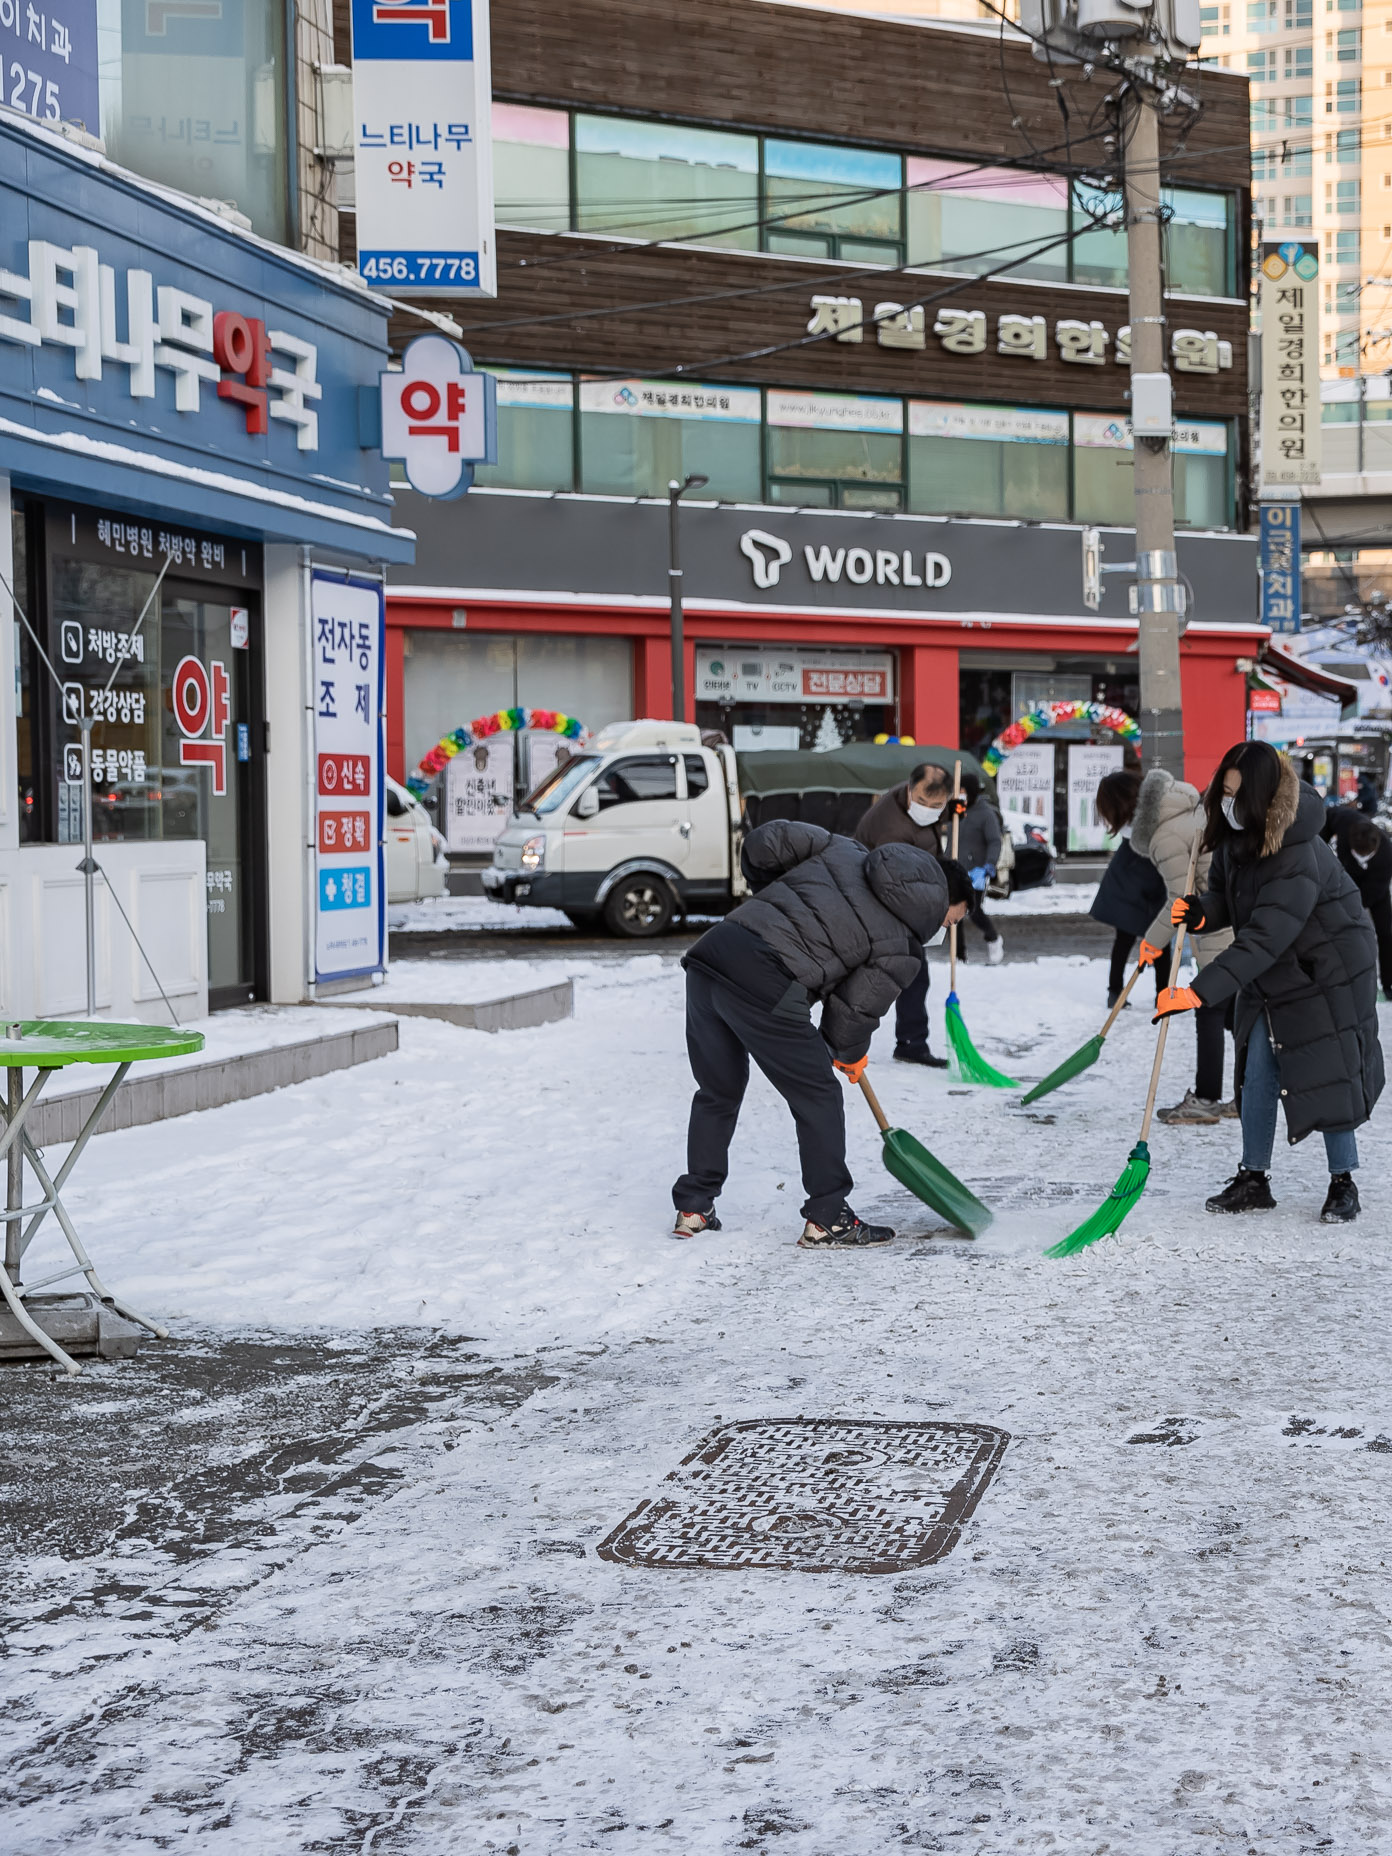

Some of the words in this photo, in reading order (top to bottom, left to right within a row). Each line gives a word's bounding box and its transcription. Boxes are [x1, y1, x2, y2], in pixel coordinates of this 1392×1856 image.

[360, 122, 473, 152] 느티나무
[388, 160, 447, 190] 약국
[362, 256, 477, 281] 456.7778
[1275, 286, 1306, 461] 제일경희한의원
[400, 380, 467, 453] 약
[97, 518, 153, 559] 혜민병원
[158, 531, 197, 567] 처방약
[200, 538, 225, 570] 완비
[804, 543, 952, 589] WORLD
[88, 627, 145, 664] 처방조제
[317, 616, 372, 671] 전자동
[808, 670, 882, 694] 전문상담
[89, 688, 146, 725] 건강상담
[172, 654, 231, 797] 약
[90, 748, 147, 783] 동물약품
[340, 759, 365, 791] 신속
[340, 815, 366, 847] 정확
[341, 872, 366, 905] 청결
